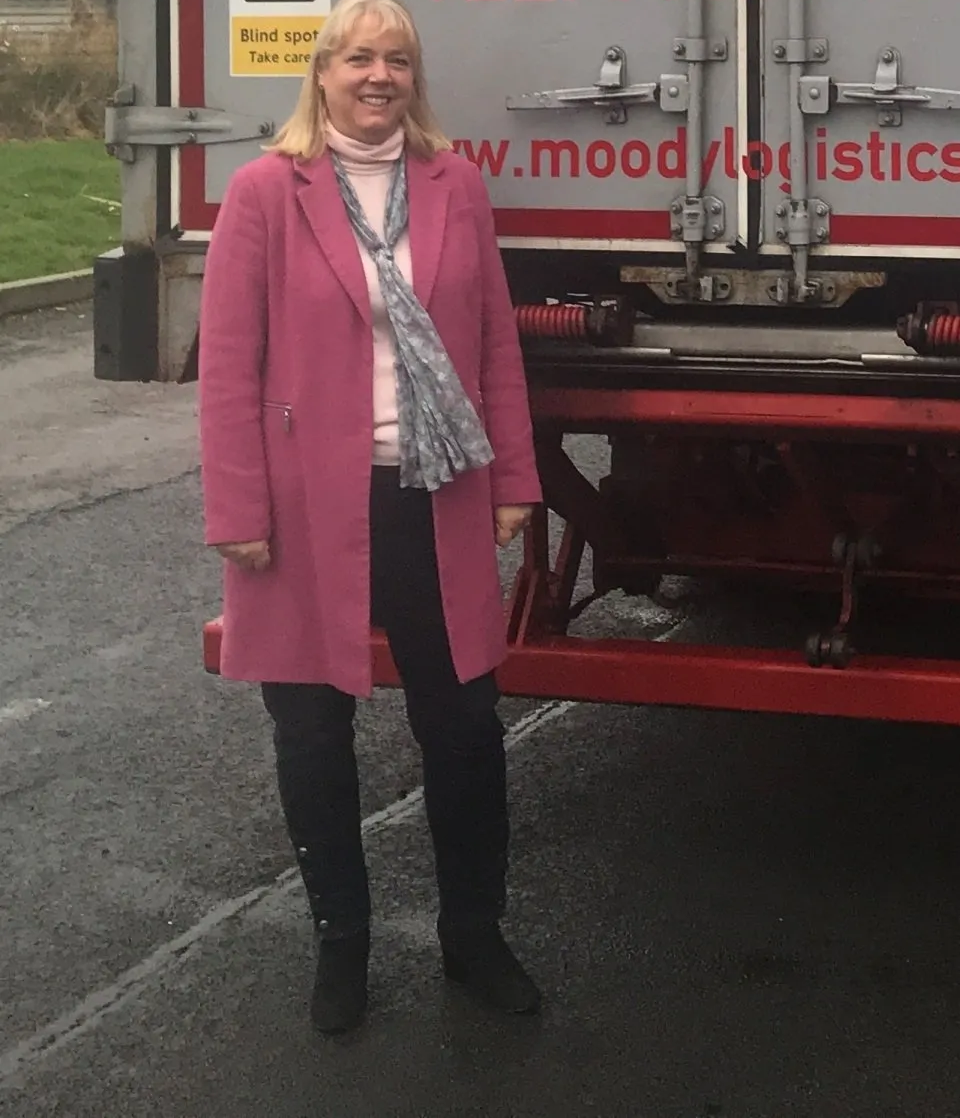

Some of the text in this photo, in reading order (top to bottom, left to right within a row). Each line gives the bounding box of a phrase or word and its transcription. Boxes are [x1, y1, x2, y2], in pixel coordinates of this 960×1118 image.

[240, 28, 278, 42] Blind
[249, 51, 312, 64] Take care
